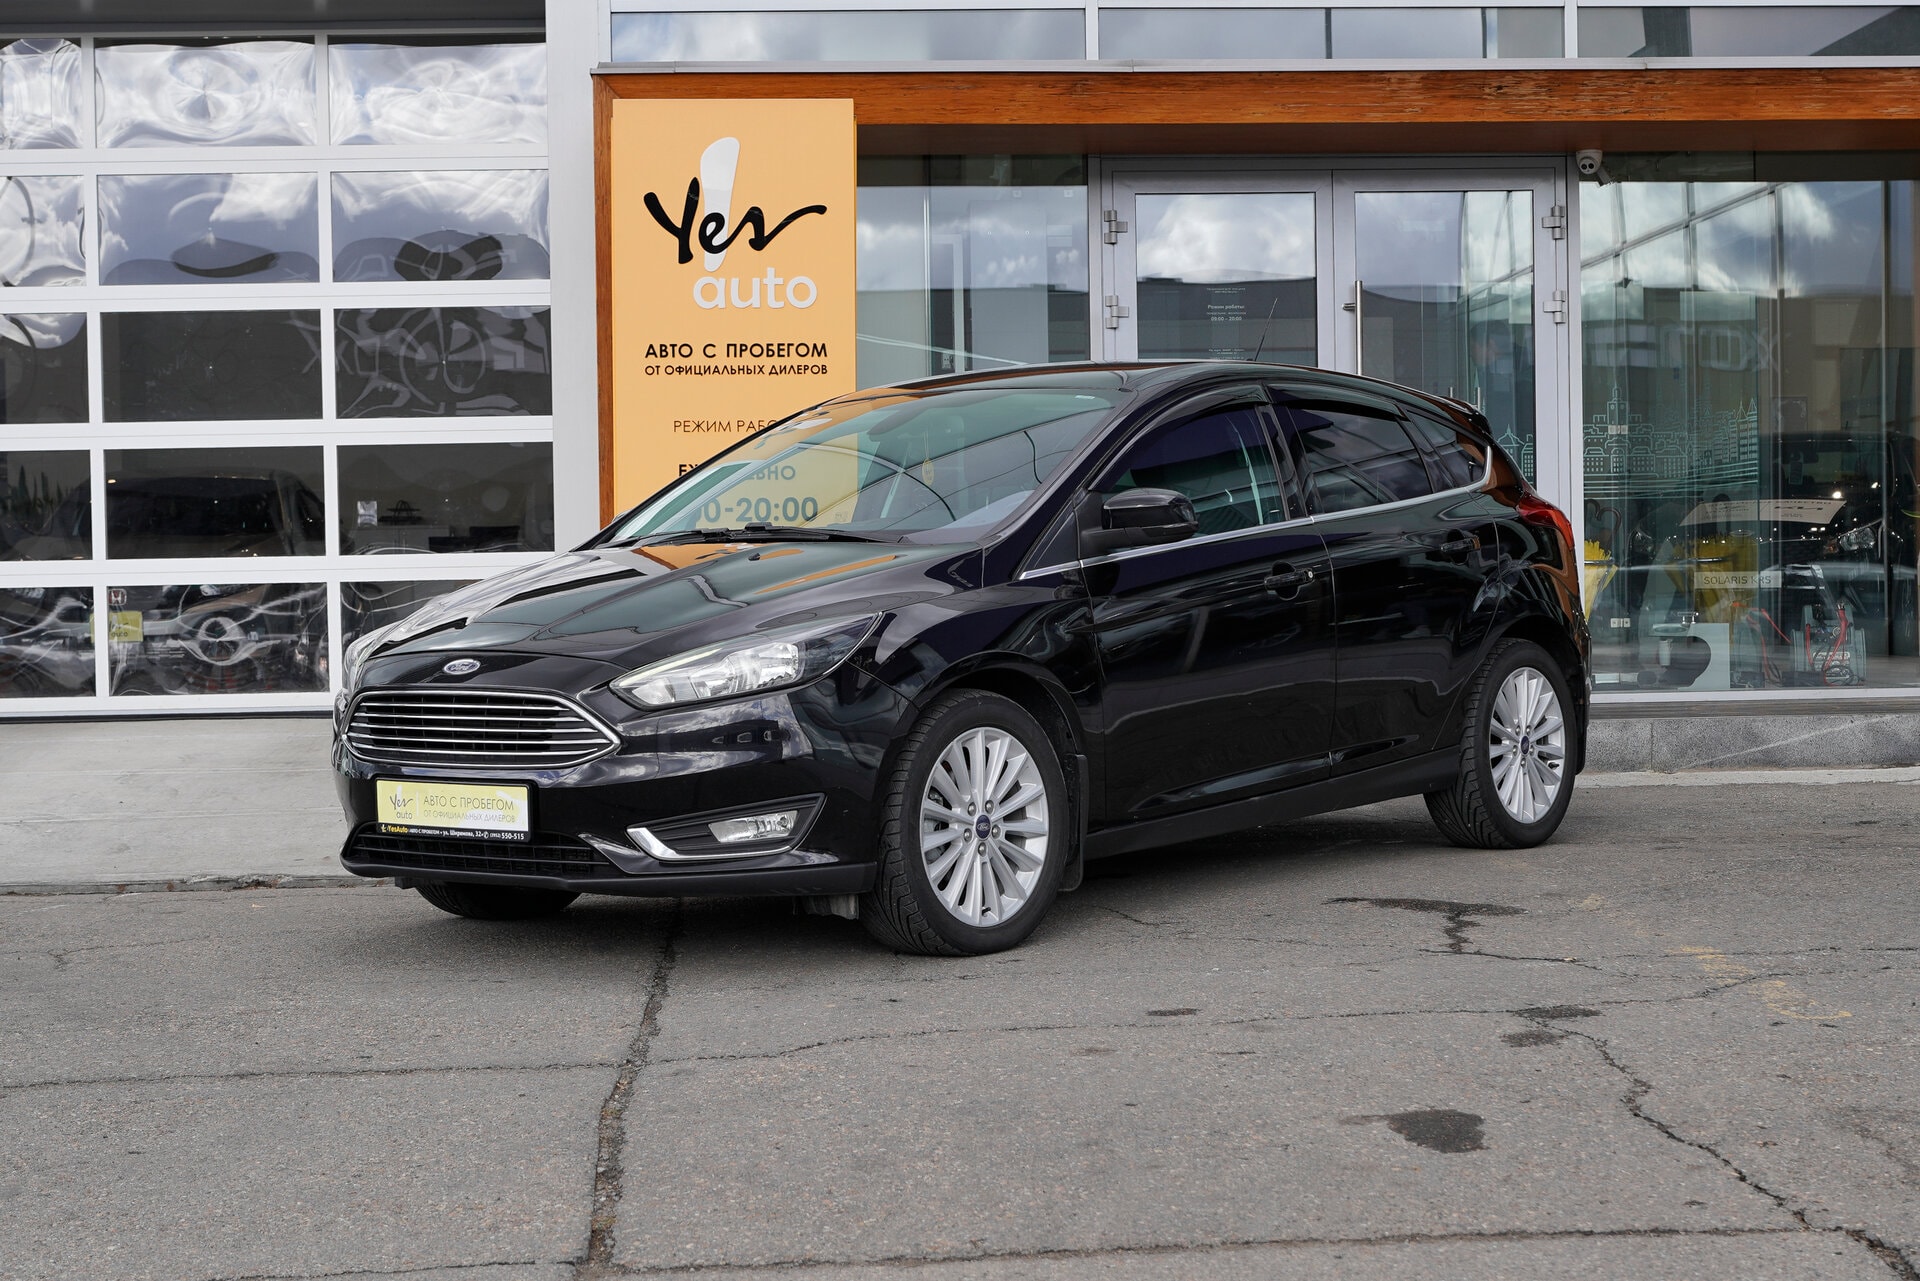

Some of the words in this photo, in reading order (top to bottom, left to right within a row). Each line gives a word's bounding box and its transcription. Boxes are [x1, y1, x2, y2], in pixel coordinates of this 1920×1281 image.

[693, 267, 818, 309] auto
[645, 343, 693, 358] АВТО
[703, 343, 716, 358] С
[726, 343, 828, 358] ПРОБЕГОМ
[645, 365, 660, 376] ОТ
[664, 364, 765, 377] ОФИЦИАЛЬНЫХ
[768, 364, 828, 376] ДИЛЕРОВ
[673, 420, 732, 433] РЕЖИМ
[1703, 575, 1748, 585] SOLARIS
[423, 795, 447, 807] АВТО
[450, 796, 457, 808] С
[460, 796, 514, 811] ПРОБЕГОМ
[396, 811, 412, 820] auto
[423, 809, 432, 818] ОТ
[483, 813, 515, 823] ДИЛЕРОВ
[501, 832, 525, 840] 550-515
